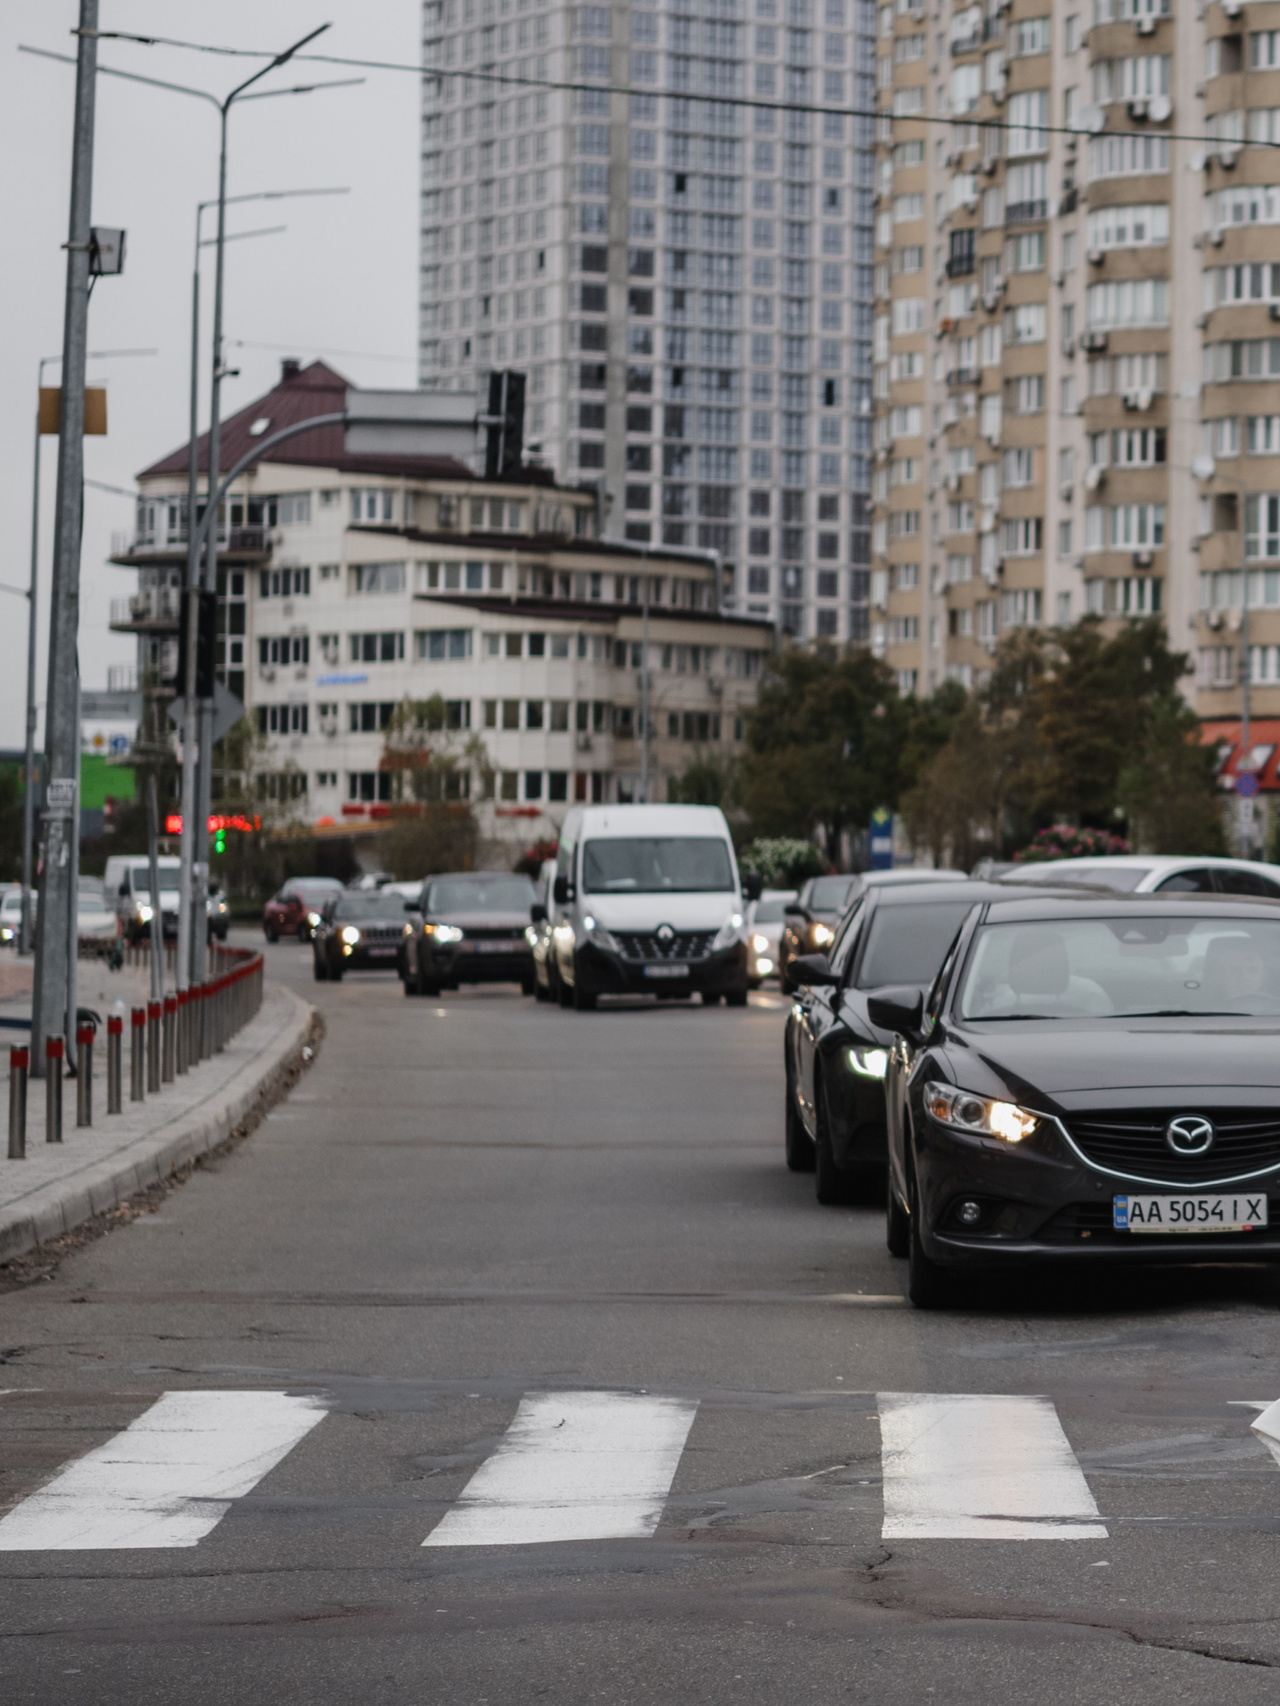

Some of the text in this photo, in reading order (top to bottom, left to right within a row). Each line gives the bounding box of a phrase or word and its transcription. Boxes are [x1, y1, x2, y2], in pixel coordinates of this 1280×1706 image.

[1116, 1215, 1128, 1224] UA
[1130, 1201, 1162, 1223] AA
[1169, 1200, 1223, 1222] 5054
